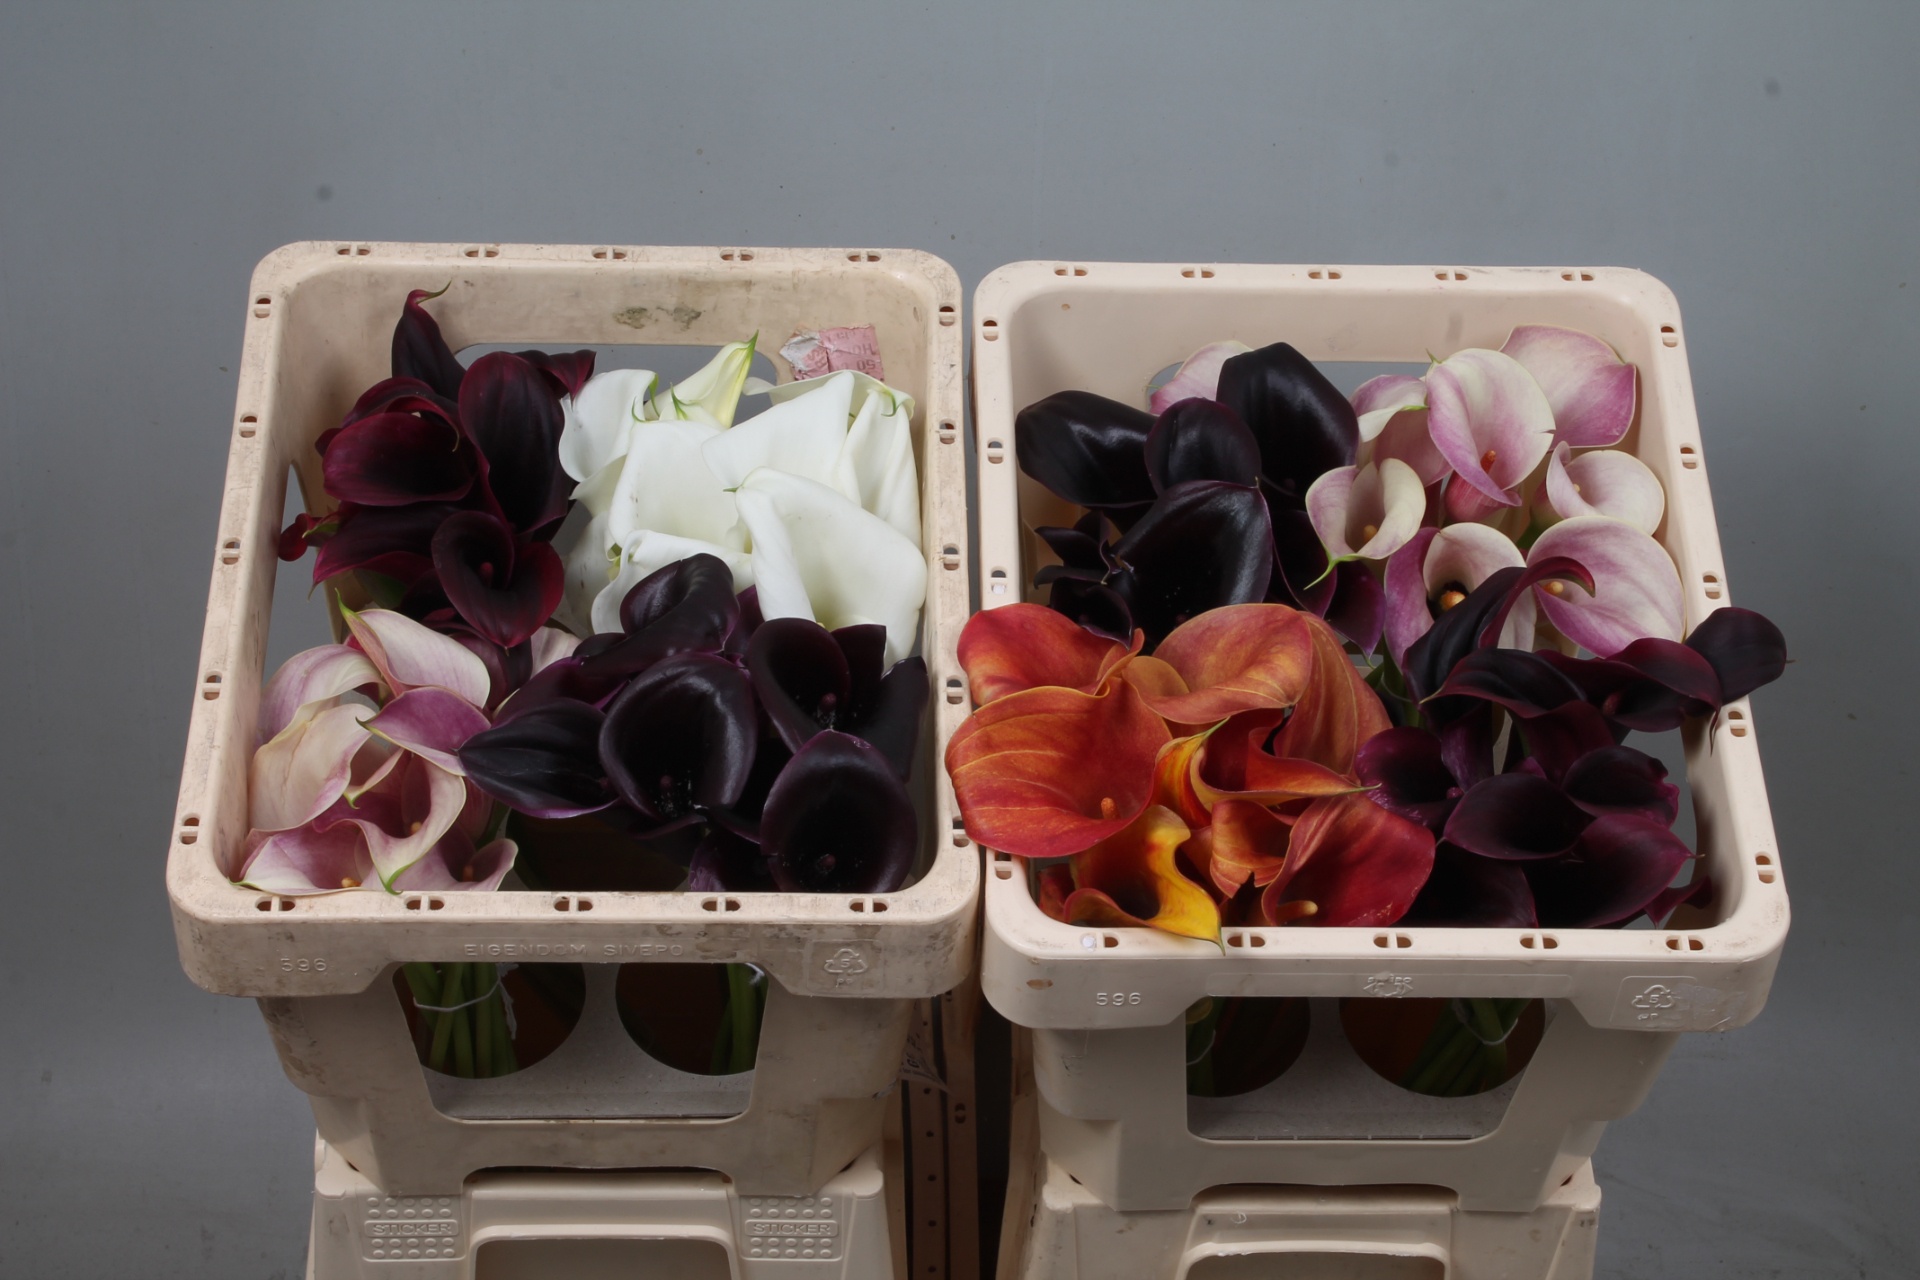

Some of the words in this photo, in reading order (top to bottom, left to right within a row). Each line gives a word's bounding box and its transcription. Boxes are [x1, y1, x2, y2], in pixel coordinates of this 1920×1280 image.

[464, 943, 587, 957] EIGENDOM
[603, 943, 684, 957] SIVEPO
[280, 957, 327, 972] 596
[1096, 992, 1141, 1006] 596
[373, 1223, 452, 1236] STICKER
[753, 1223, 831, 1236] STICKER
